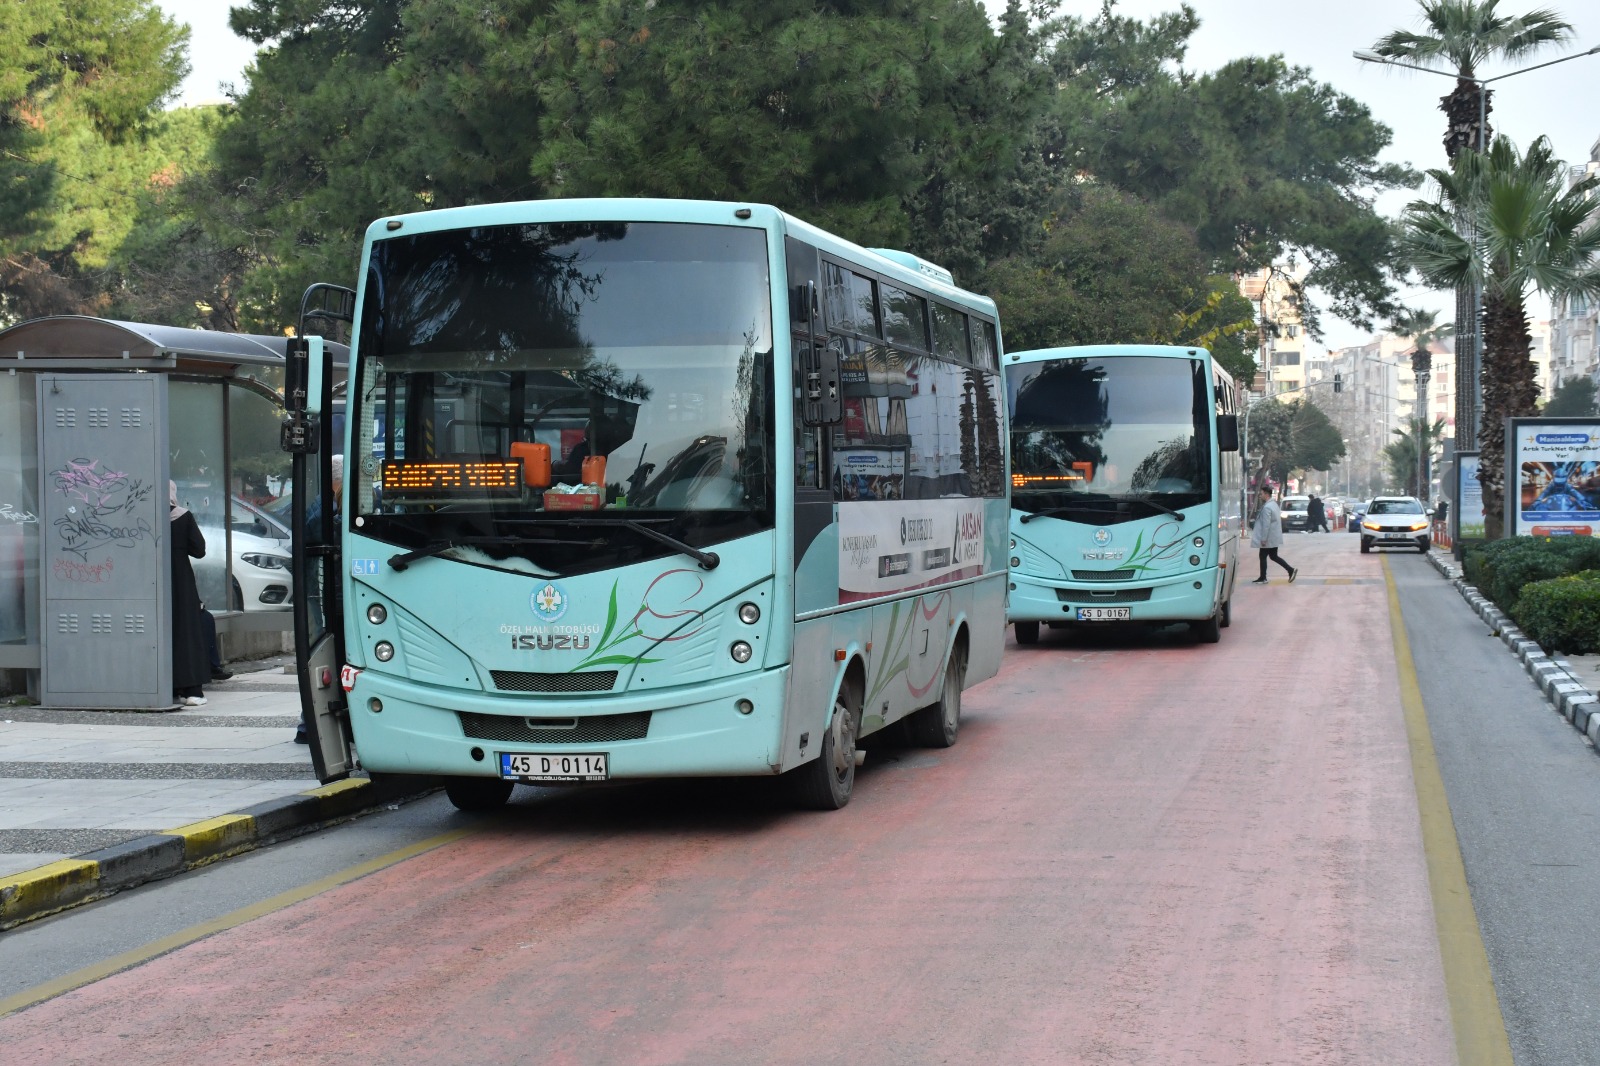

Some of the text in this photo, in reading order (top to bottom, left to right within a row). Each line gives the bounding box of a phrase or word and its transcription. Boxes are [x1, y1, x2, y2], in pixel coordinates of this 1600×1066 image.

[962, 511, 982, 541] AKSAN
[1083, 552, 1123, 560] ISUZU
[1082, 609, 1128, 618] 45 D 0167
[500, 623, 522, 634] ÖZEL
[552, 623, 600, 634] OTOBÜSÜ
[512, 634, 590, 650] ISUZU
[511, 757, 603, 774] 45 D 0114
